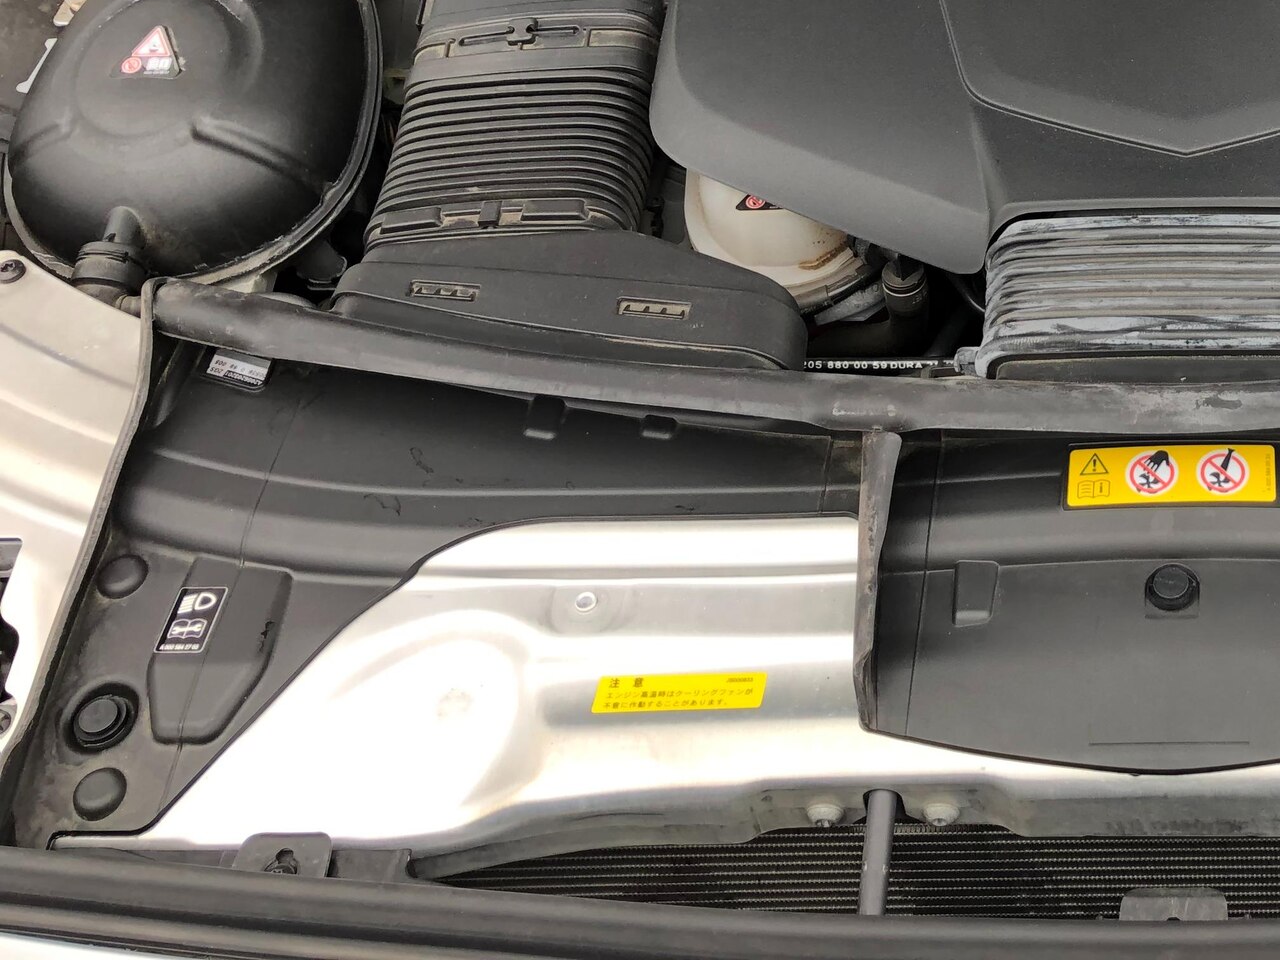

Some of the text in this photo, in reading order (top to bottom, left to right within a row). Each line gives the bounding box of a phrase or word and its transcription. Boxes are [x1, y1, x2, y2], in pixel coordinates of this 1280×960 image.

[827, 360, 849, 369] 880
[853, 360, 868, 369] 00
[872, 360, 887, 370] 59
[889, 360, 923, 370] DURA
